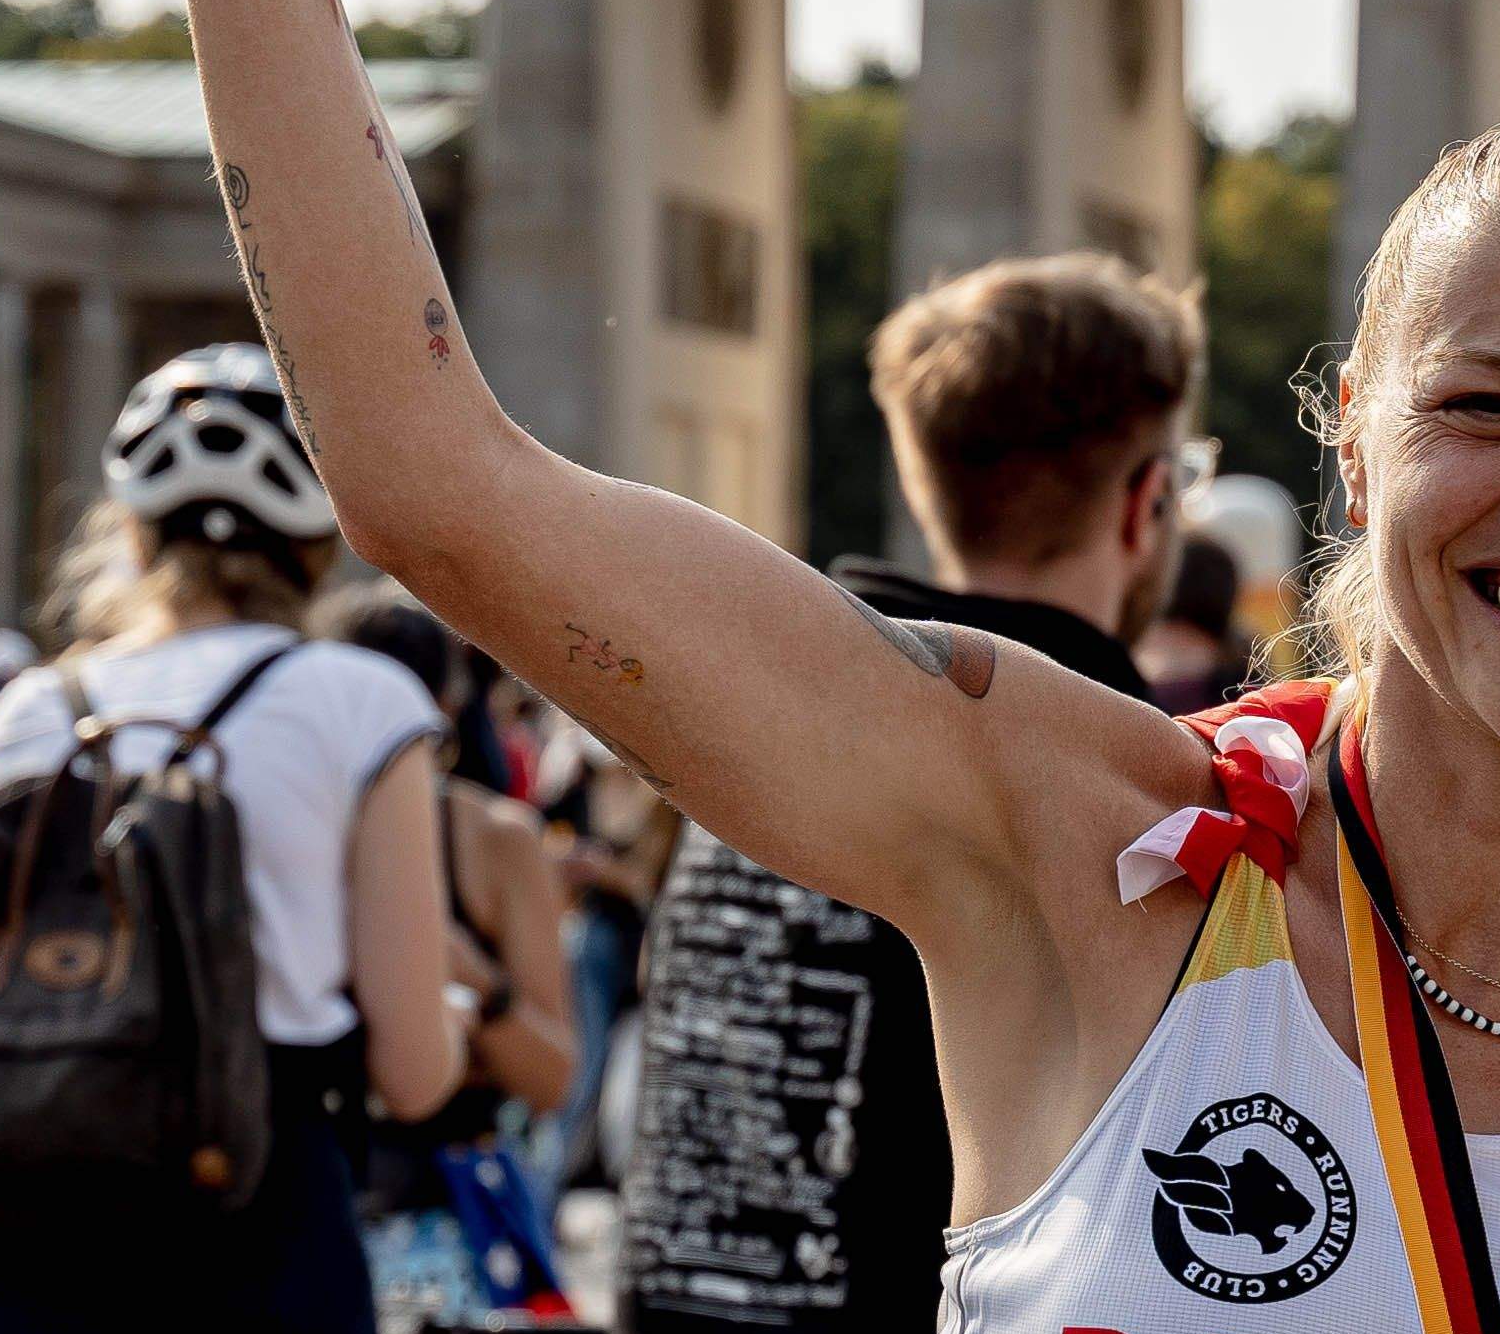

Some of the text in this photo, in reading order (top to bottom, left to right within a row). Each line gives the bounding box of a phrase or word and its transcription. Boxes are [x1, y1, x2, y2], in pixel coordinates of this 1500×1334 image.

[1200, 1099, 1299, 1135] TIGERS
[1296, 1151, 1351, 1283] RUNNING
[1182, 1261, 1266, 1298] CLUB
